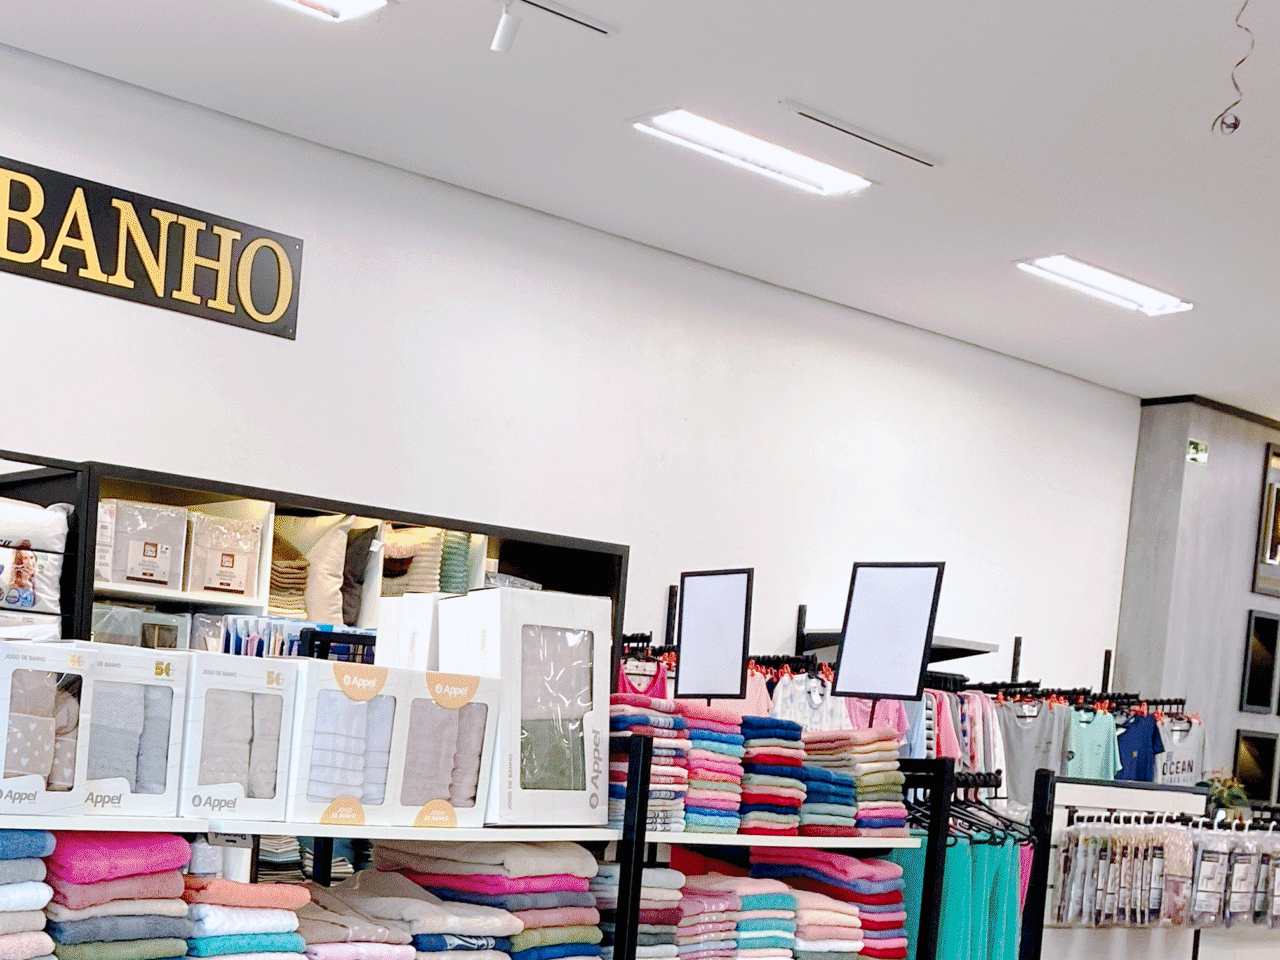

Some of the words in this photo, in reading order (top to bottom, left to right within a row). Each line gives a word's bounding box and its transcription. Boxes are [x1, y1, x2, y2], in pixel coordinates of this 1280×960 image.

[352, 676, 376, 689] Appel
[444, 684, 468, 696] Appel
[590, 729, 602, 790] Appel
[1162, 759, 1194, 776] OCEAN
[4, 789, 37, 804] Appel
[84, 792, 122, 807] Appel
[203, 796, 237, 811] Appel
